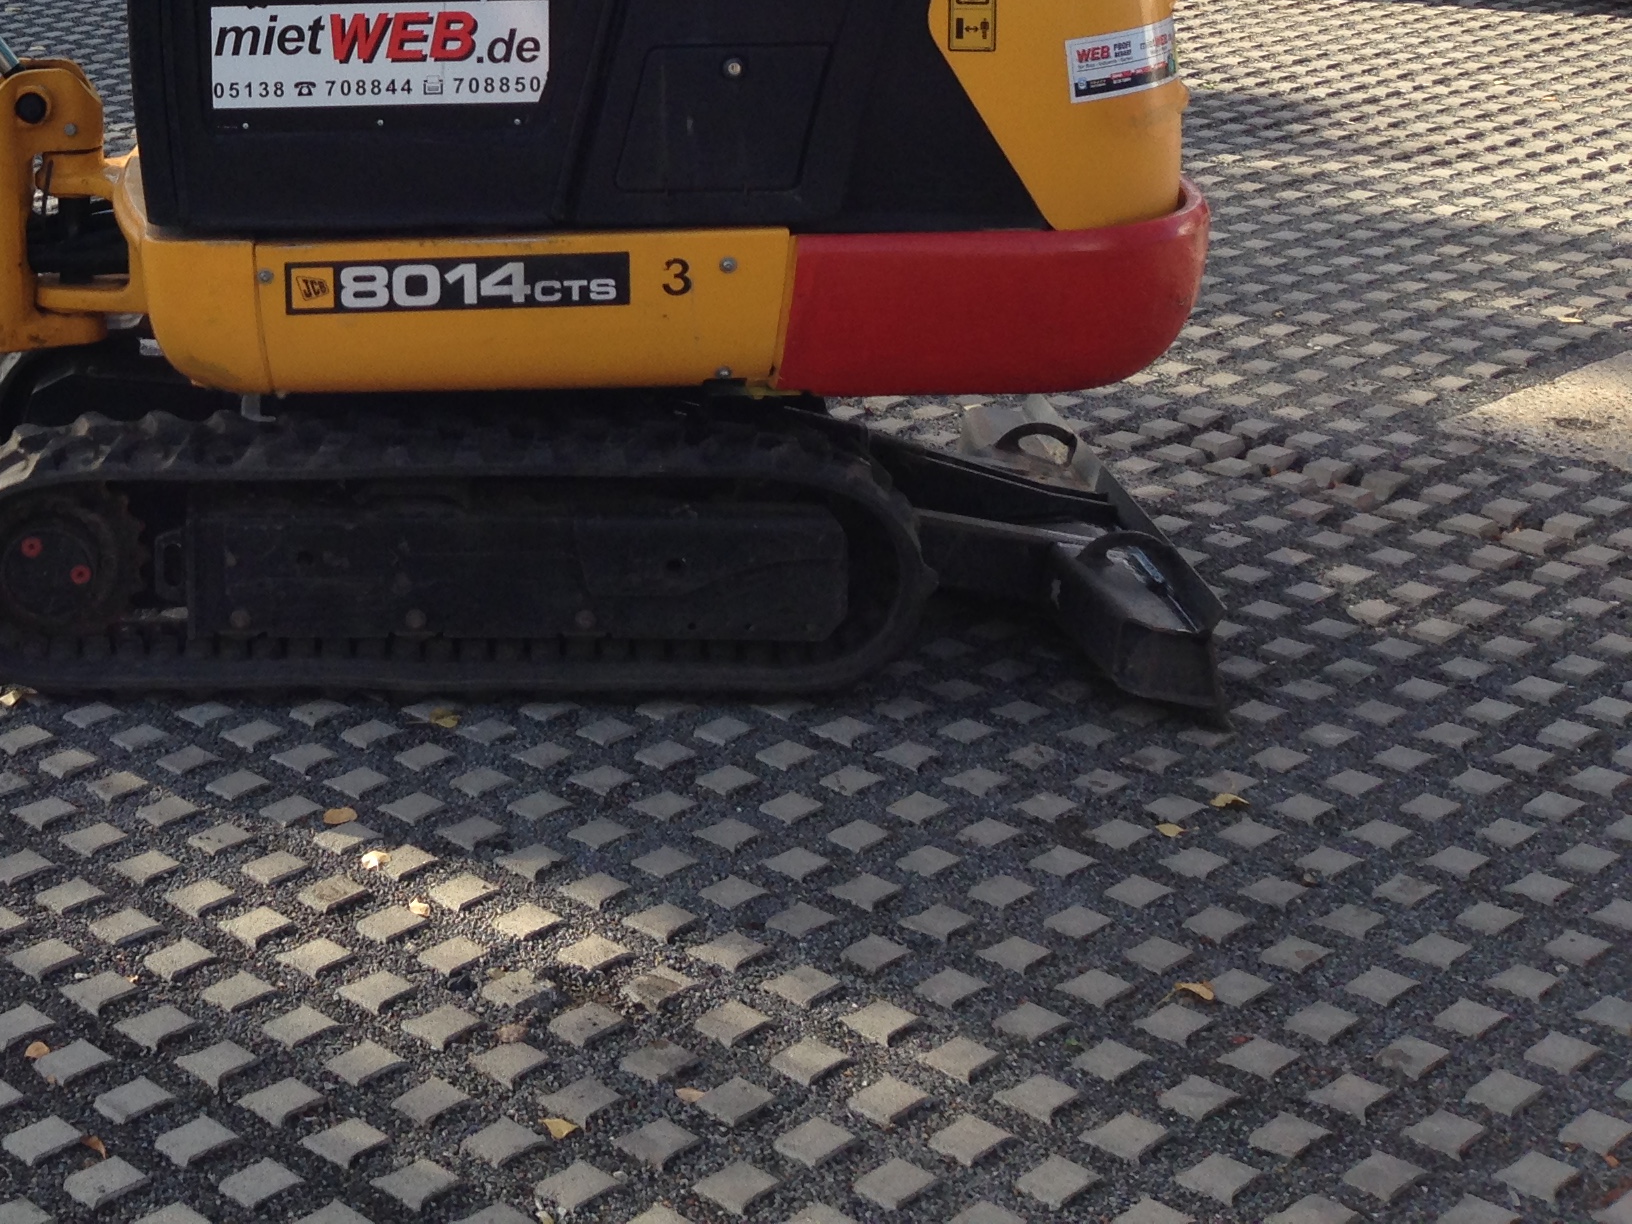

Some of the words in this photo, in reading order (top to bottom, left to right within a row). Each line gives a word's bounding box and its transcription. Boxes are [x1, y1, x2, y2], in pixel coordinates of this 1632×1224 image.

[214, 10, 541, 64] mietWEB.de
[1076, 44, 1111, 64] WEB
[213, 81, 285, 99] 05138
[325, 78, 414, 96] 708844
[453, 76, 541, 95] 708850
[302, 278, 327, 298] JCB
[661, 257, 693, 296] 3
